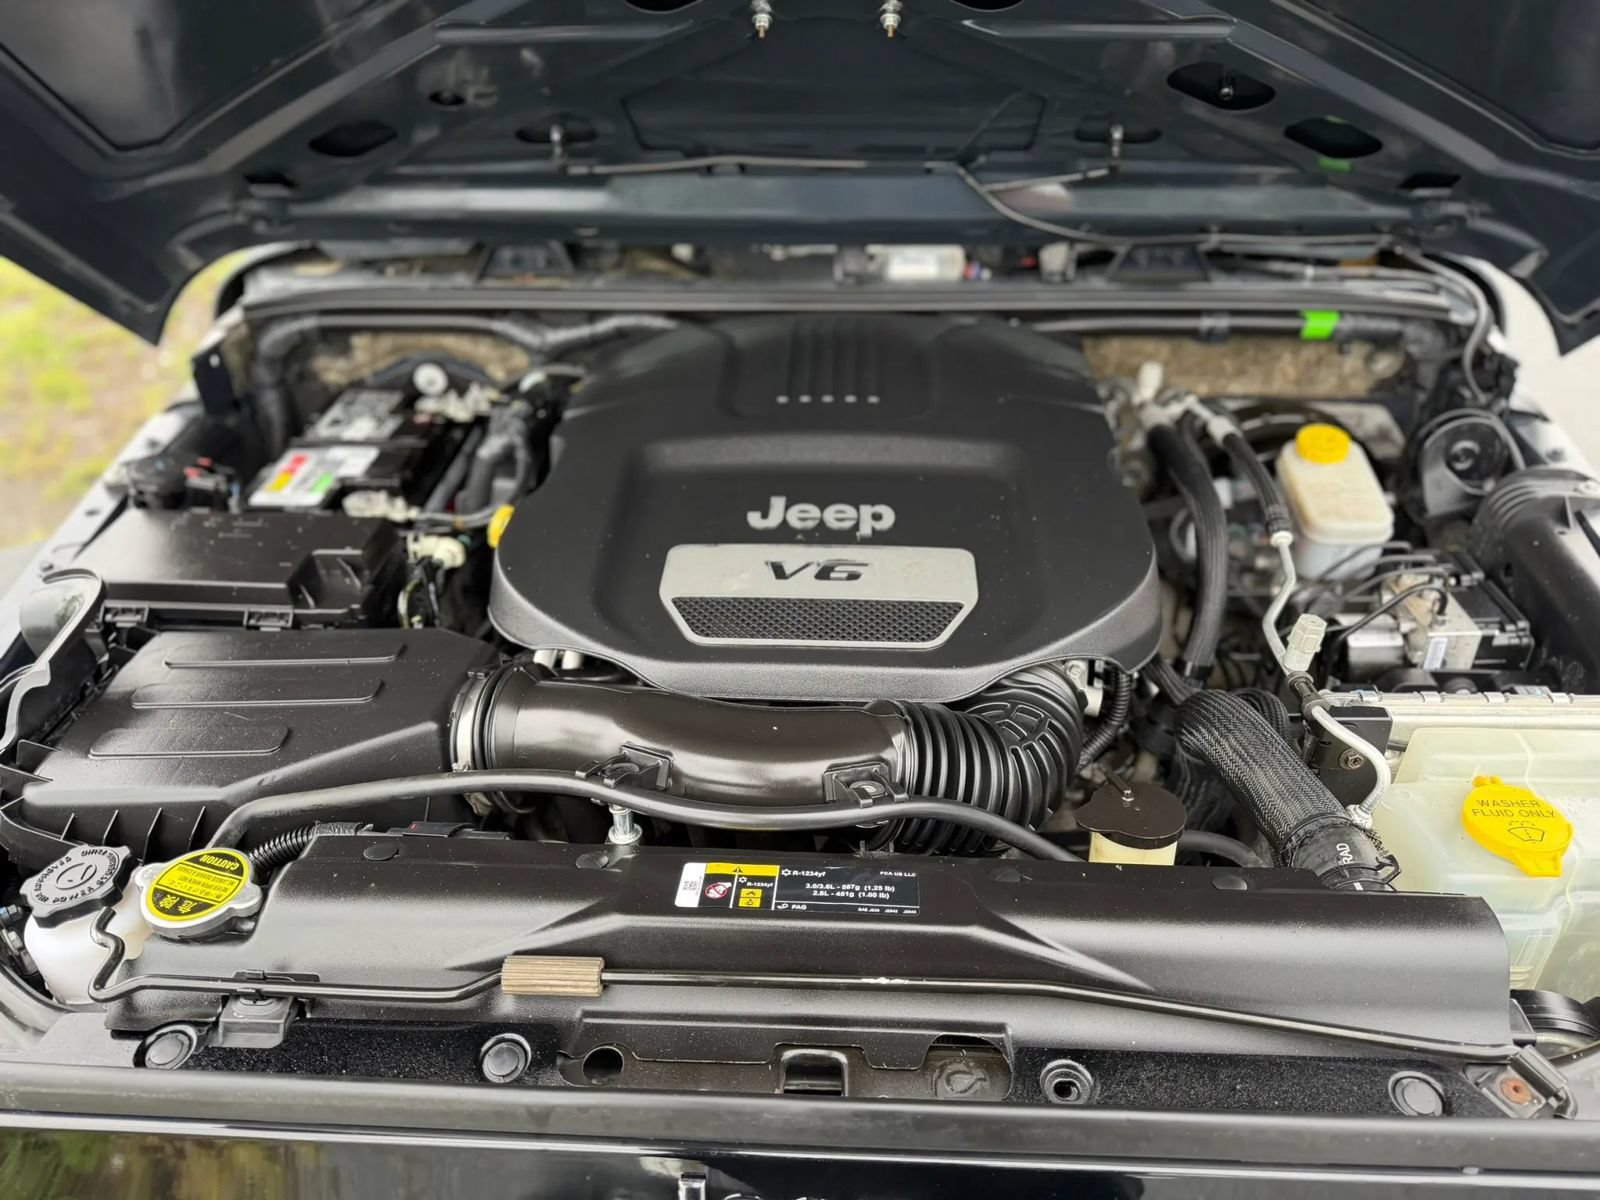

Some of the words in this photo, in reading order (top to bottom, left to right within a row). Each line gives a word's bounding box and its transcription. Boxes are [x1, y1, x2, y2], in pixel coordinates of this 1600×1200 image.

[746, 495, 895, 538] Jeep
[765, 559, 869, 581] V6
[1472, 809, 1514, 817] FLUID
[1519, 810, 1555, 818] ONLY
[200, 854, 240, 870] CAUTION
[1336, 843, 1355, 865] RAD
[159, 894, 197, 914] 危険
